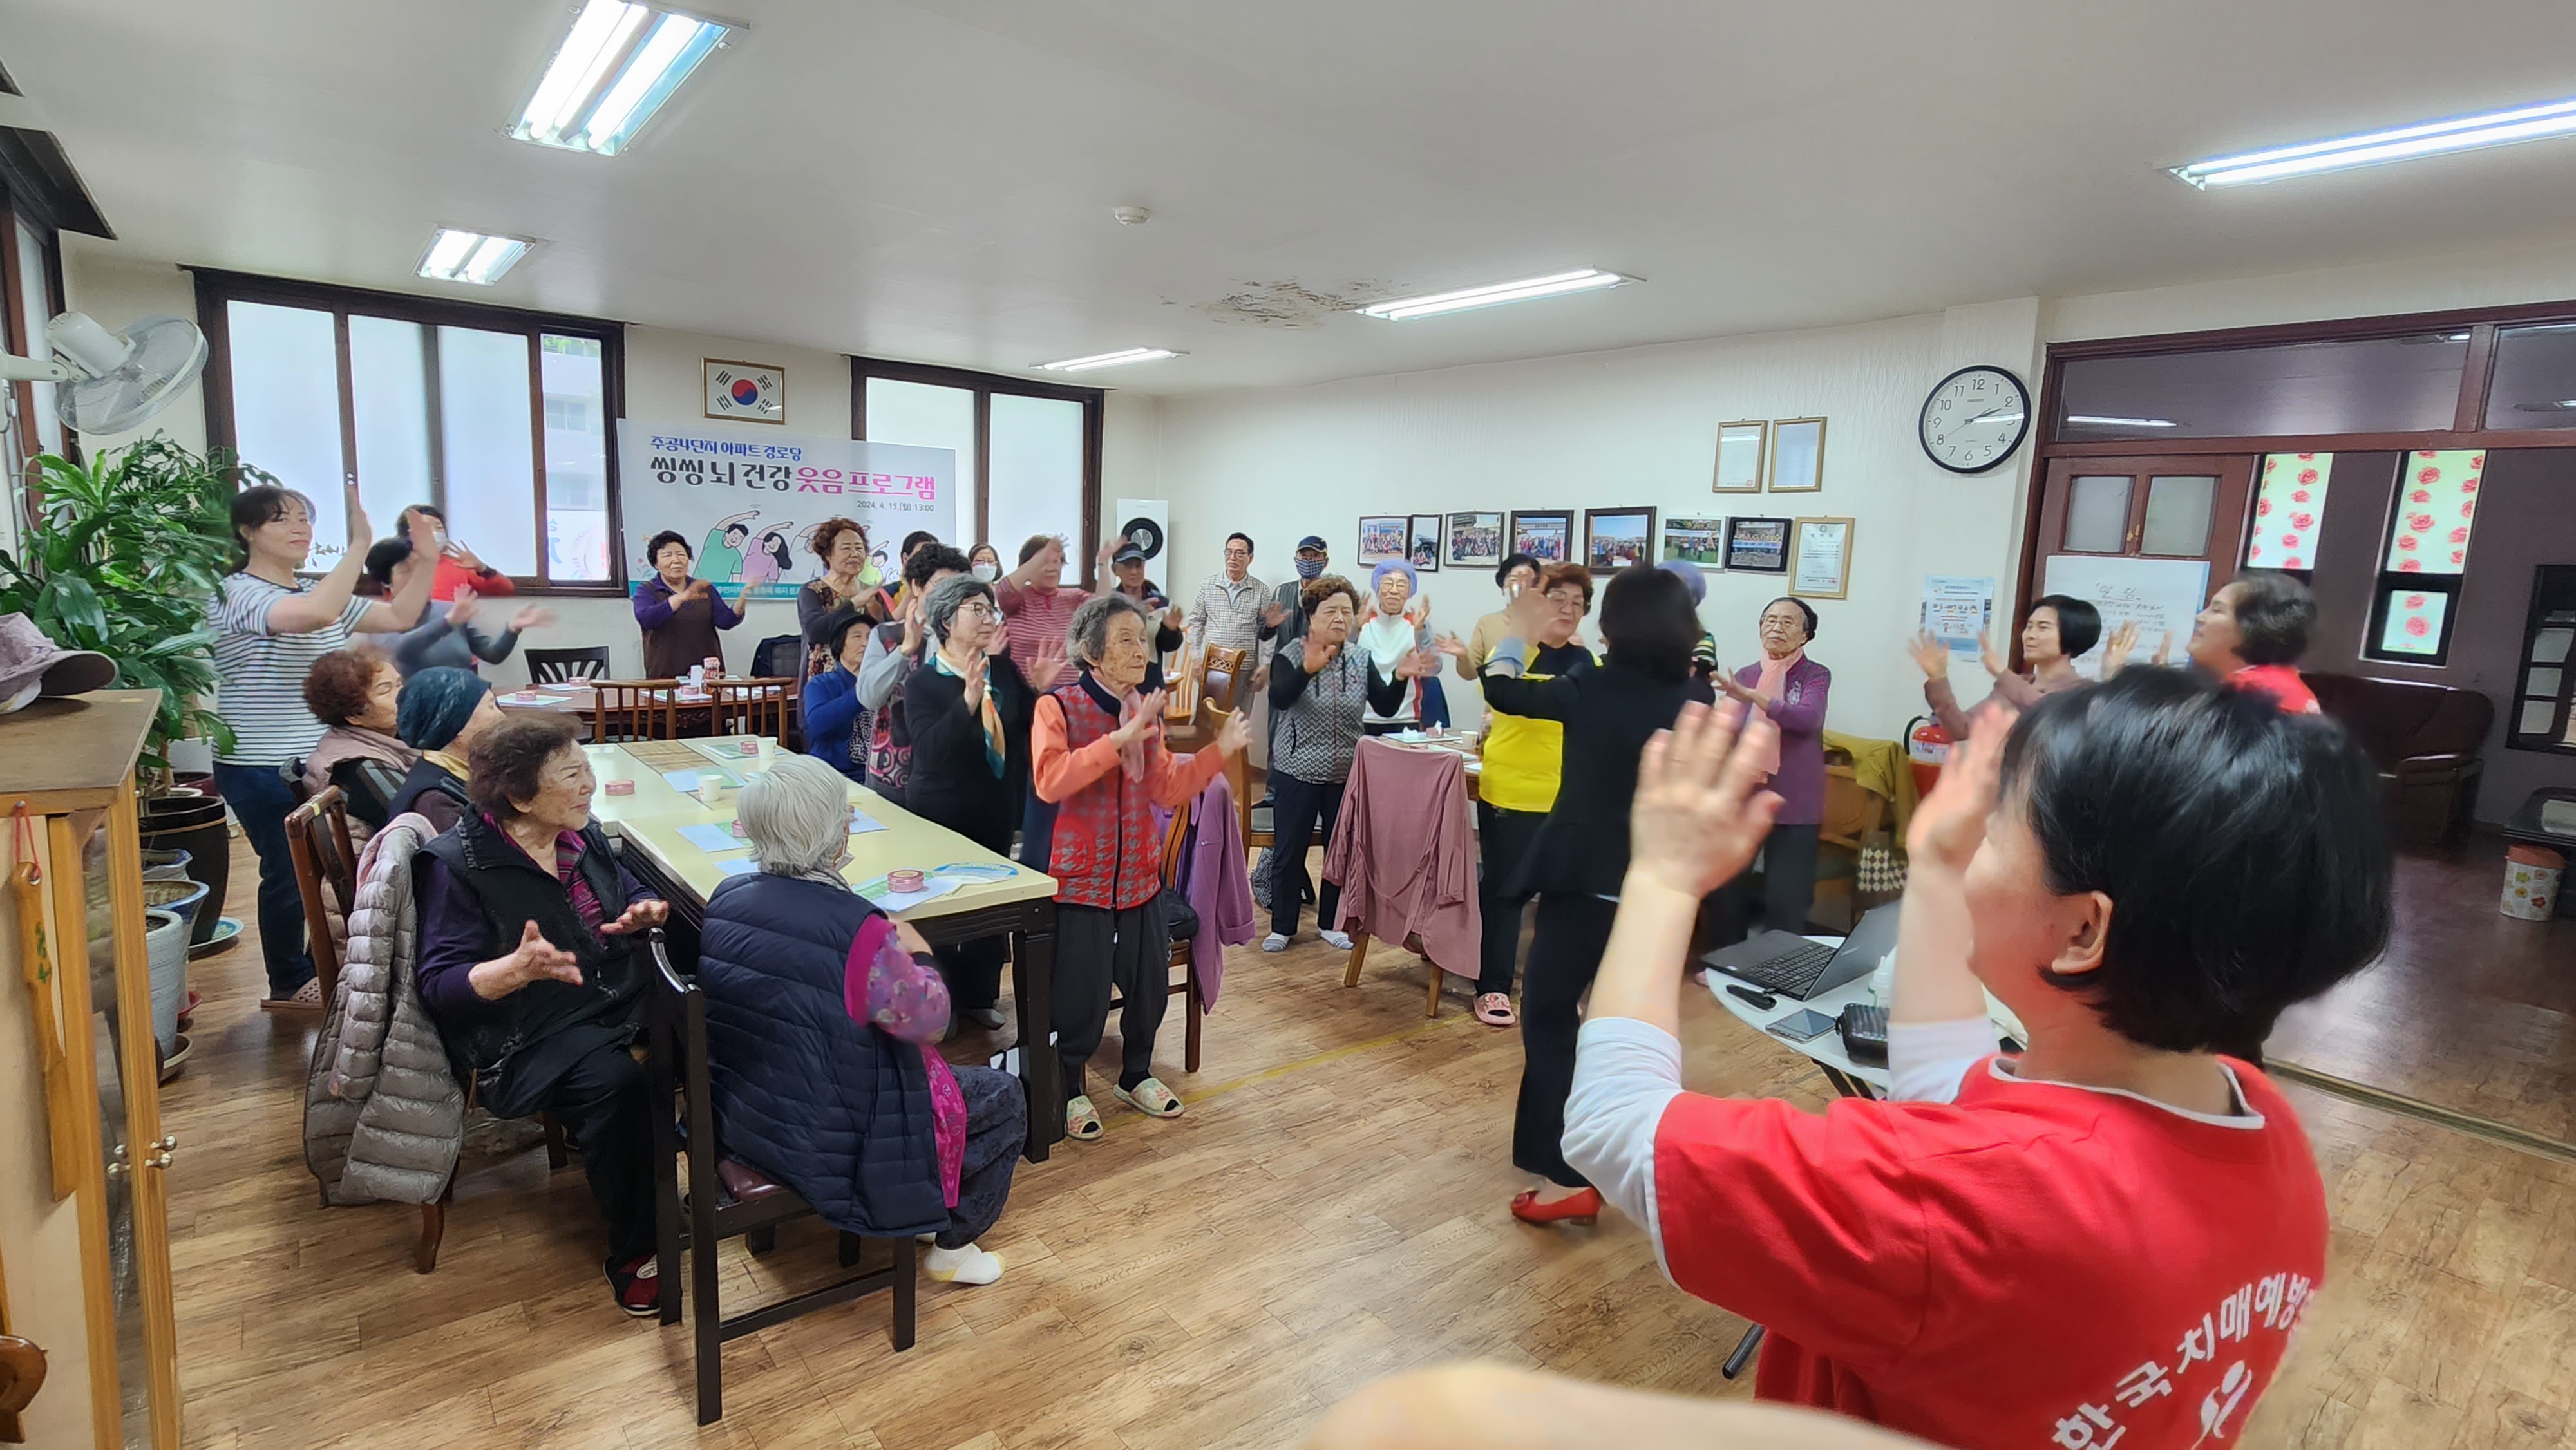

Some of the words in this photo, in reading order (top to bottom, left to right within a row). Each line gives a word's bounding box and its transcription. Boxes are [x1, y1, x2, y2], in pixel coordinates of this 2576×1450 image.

[1972, 379, 1985, 390] 12
[1994, 383, 2000, 395] 1
[1955, 385, 1964, 397] 11
[1940, 399, 1952, 411] 10
[2004, 396, 2013, 407] 2
[1933, 417, 1942, 428] 9
[1936, 434, 1944, 445] 8
[1998, 432, 2007, 444] 4
[650, 435, 717, 454] 주공4단지
[721, 442, 761, 457] 아파트
[762, 445, 802, 462] 경로당
[1949, 446, 1956, 457] 7
[1984, 445, 1992, 457] 5
[1964, 450, 1973, 461] 6
[650, 457, 704, 485] 씽씽
[710, 461, 735, 486] 뇌
[741, 464, 793, 491] 건강
[796, 467, 844, 494] 웃음
[848, 471, 935, 500] 프로그램
[857, 500, 877, 509] 2024.
[914, 504, 934, 512] 13:00
[2051, 1272, 2317, 1450] 한국치매예방
